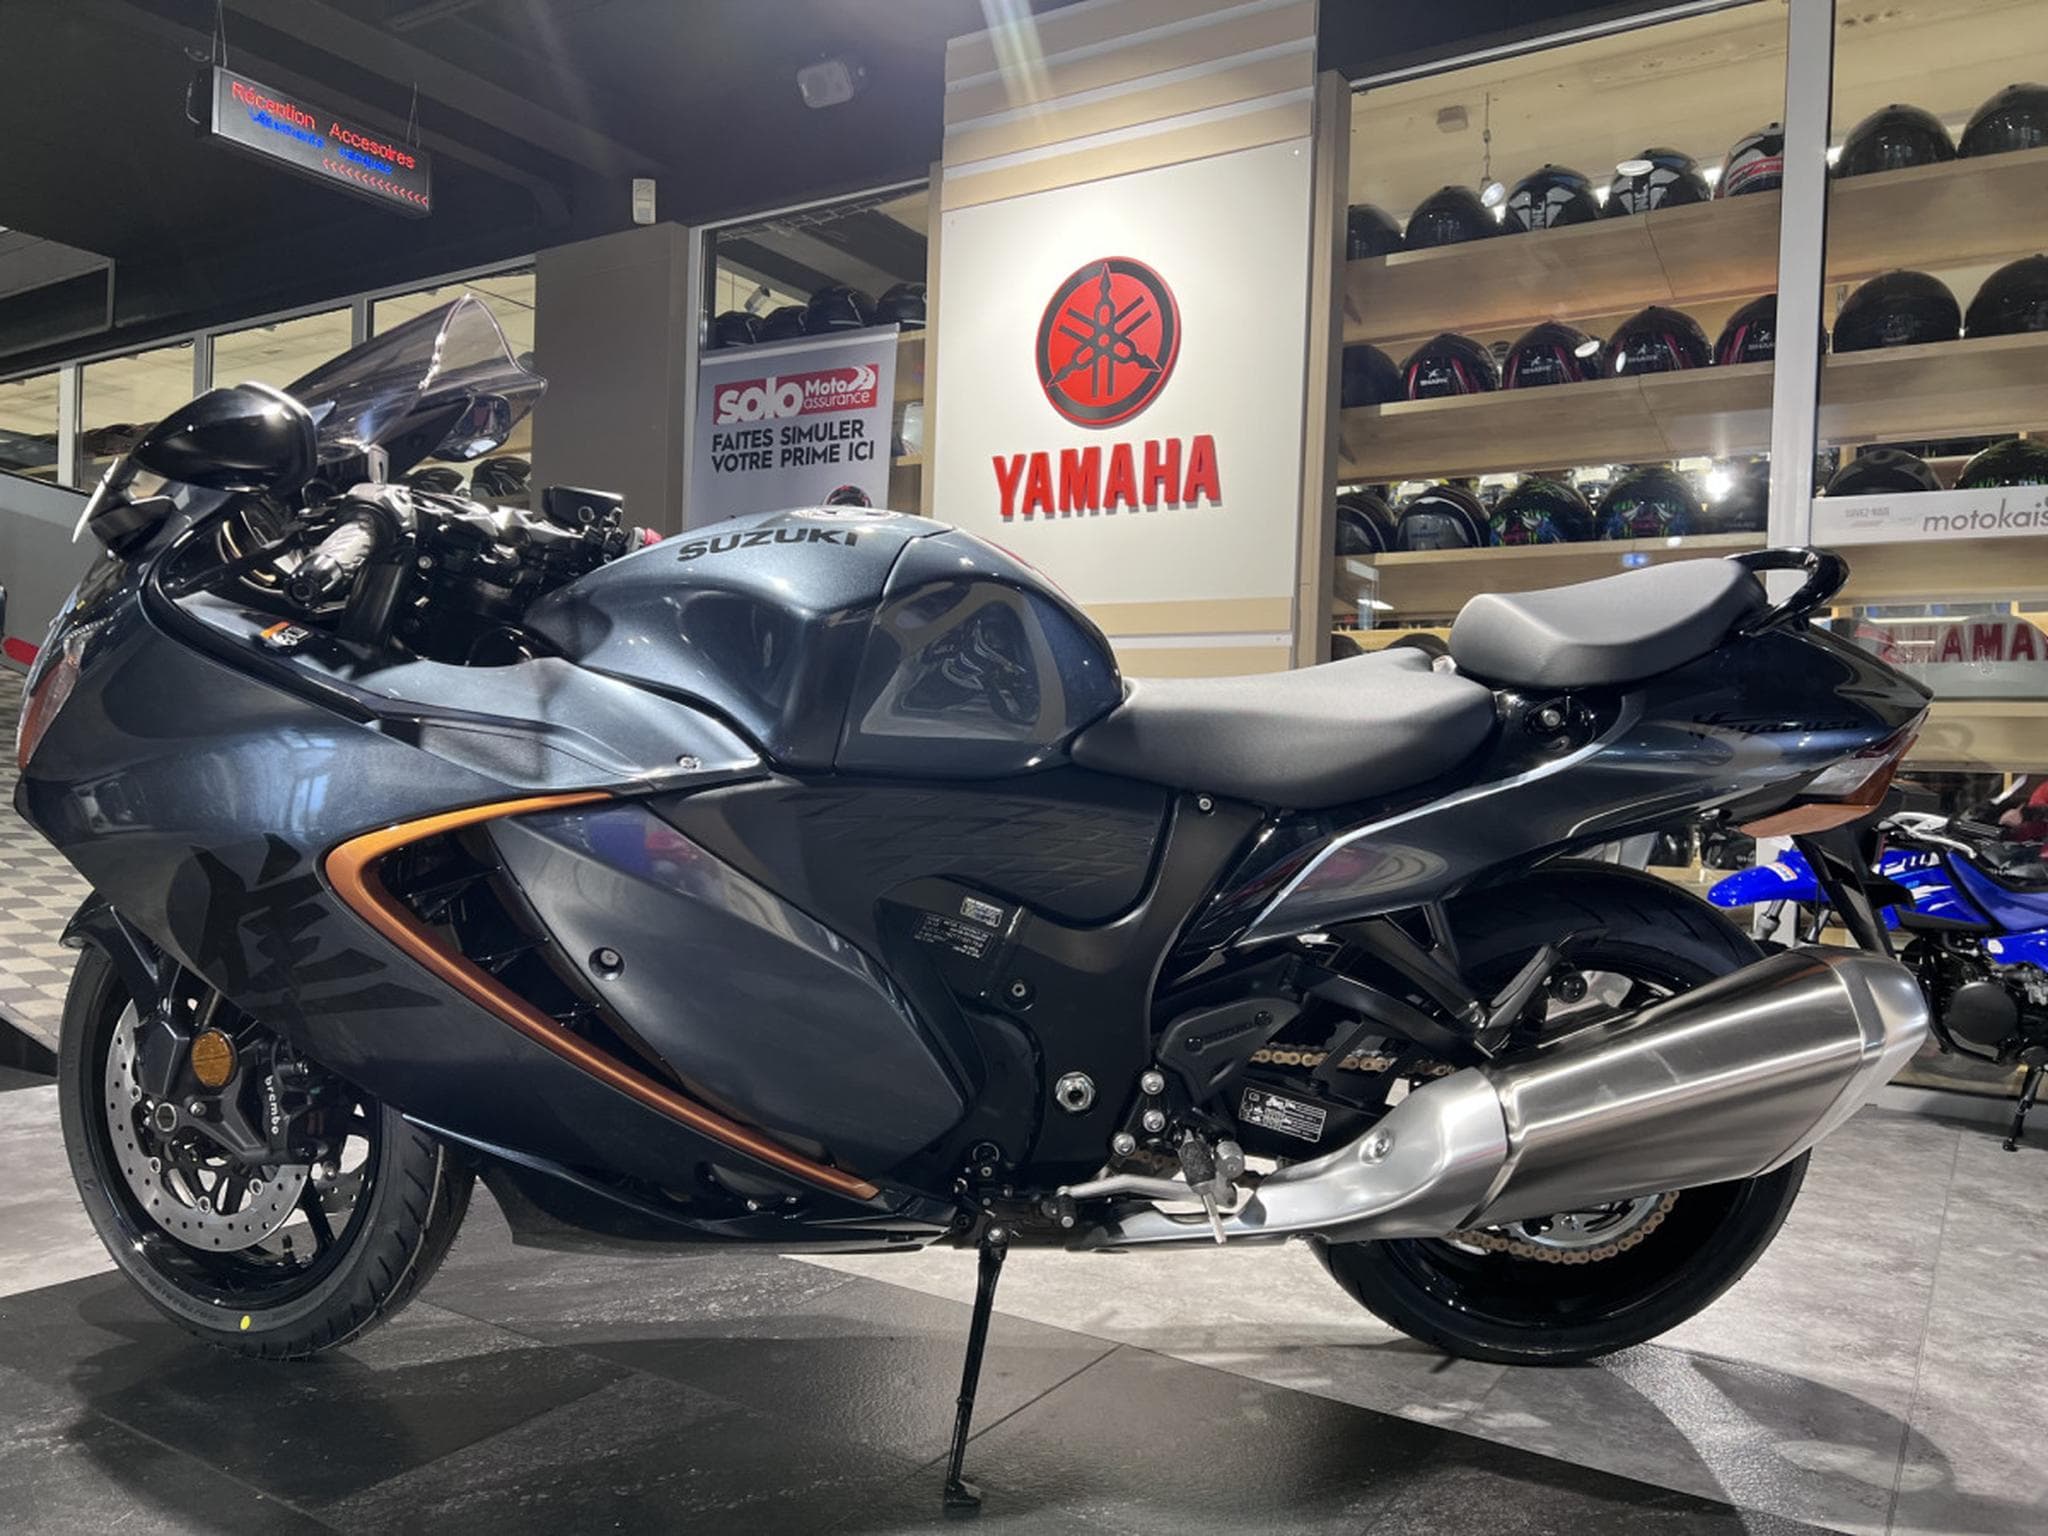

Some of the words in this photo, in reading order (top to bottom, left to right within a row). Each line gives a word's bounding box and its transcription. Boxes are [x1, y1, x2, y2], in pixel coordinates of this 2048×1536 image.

[231, 81, 316, 130] Réception
[328, 122, 415, 170] Accesoires
[717, 377, 804, 425] solo
[804, 391, 871, 410] assurance
[805, 378, 849, 397] Moto
[712, 428, 774, 453] FAITES
[780, 419, 865, 446] SIMULER
[711, 450, 773, 474] VOTRE
[780, 444, 841, 468] PRIME
[848, 441, 875, 462] ICI
[992, 434, 1222, 518] YAMAHA
[677, 528, 859, 562] SUZUKI
[264, 1075, 281, 1135] brembo
